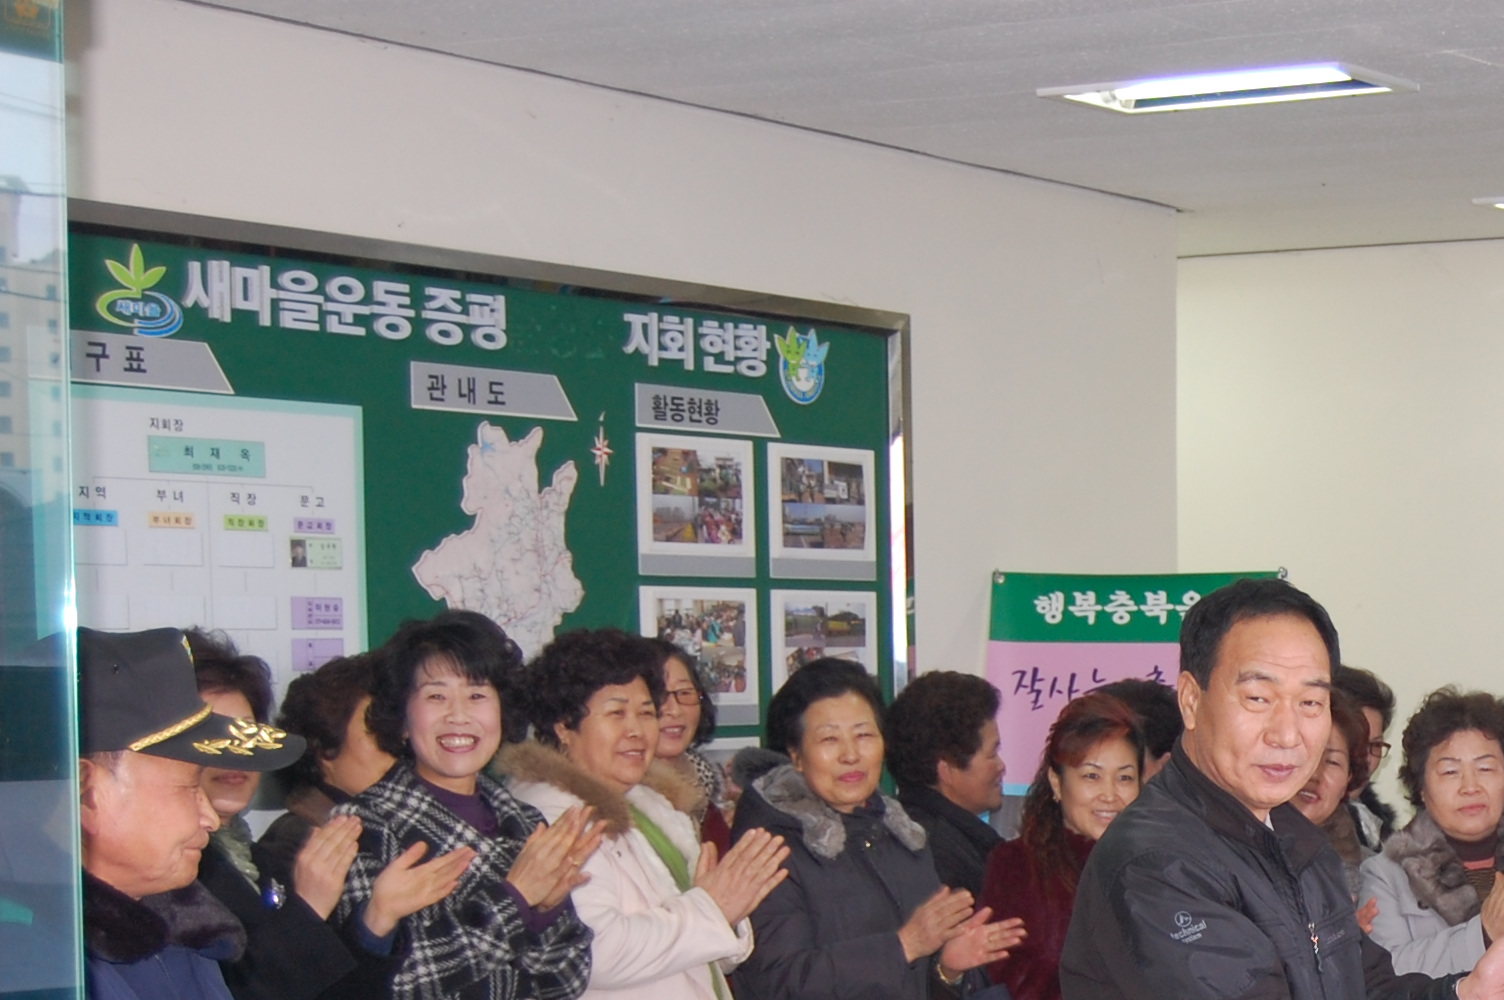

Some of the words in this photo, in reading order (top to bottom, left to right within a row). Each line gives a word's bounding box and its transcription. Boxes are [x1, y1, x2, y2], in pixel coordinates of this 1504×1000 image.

[182, 259, 416, 340] 새마을운동
[420, 285, 509, 350] 증평
[70, 340, 148, 374] 구표
[149, 417, 184, 432] 지회장
[652, 394, 721, 426] 활동현황
[1169, 919, 1207, 940] technical
